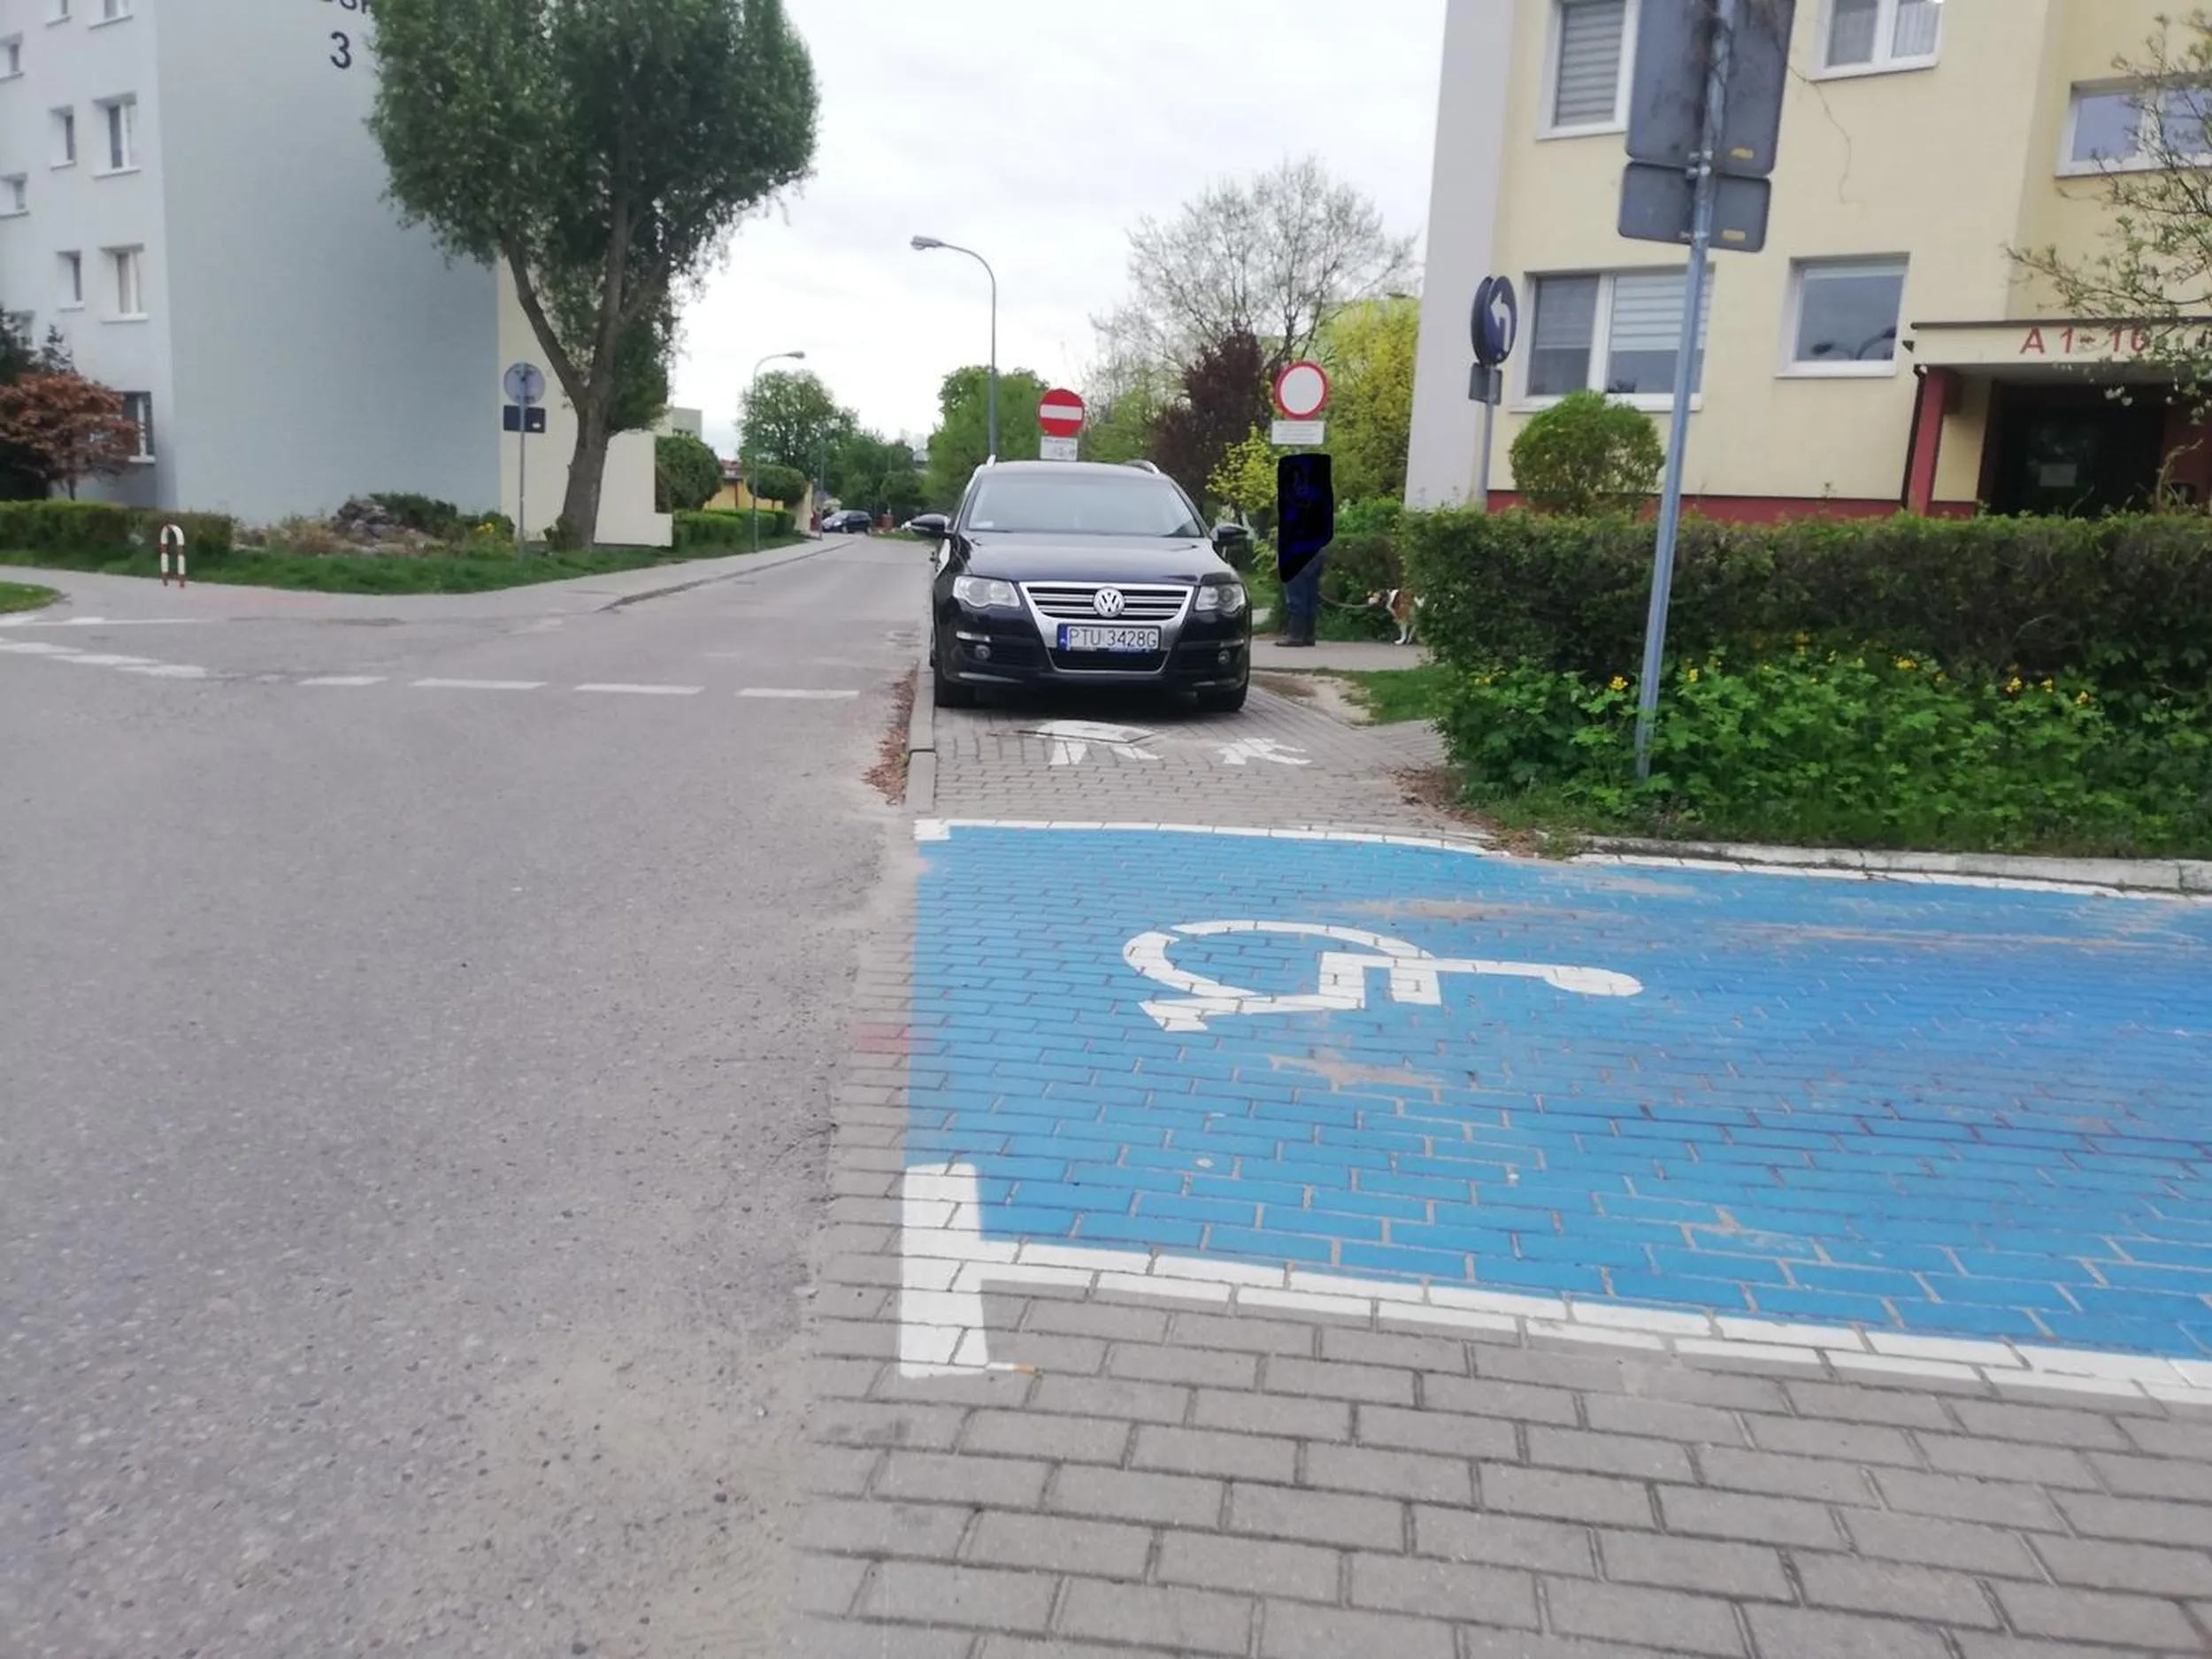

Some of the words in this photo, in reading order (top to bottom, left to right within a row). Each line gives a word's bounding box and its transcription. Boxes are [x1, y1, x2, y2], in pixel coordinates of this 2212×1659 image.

[330, 31, 351, 69] 3
[2020, 326, 2045, 354] A
[1069, 628, 1101, 646] PTU
[1107, 629, 1157, 649] 3428G
